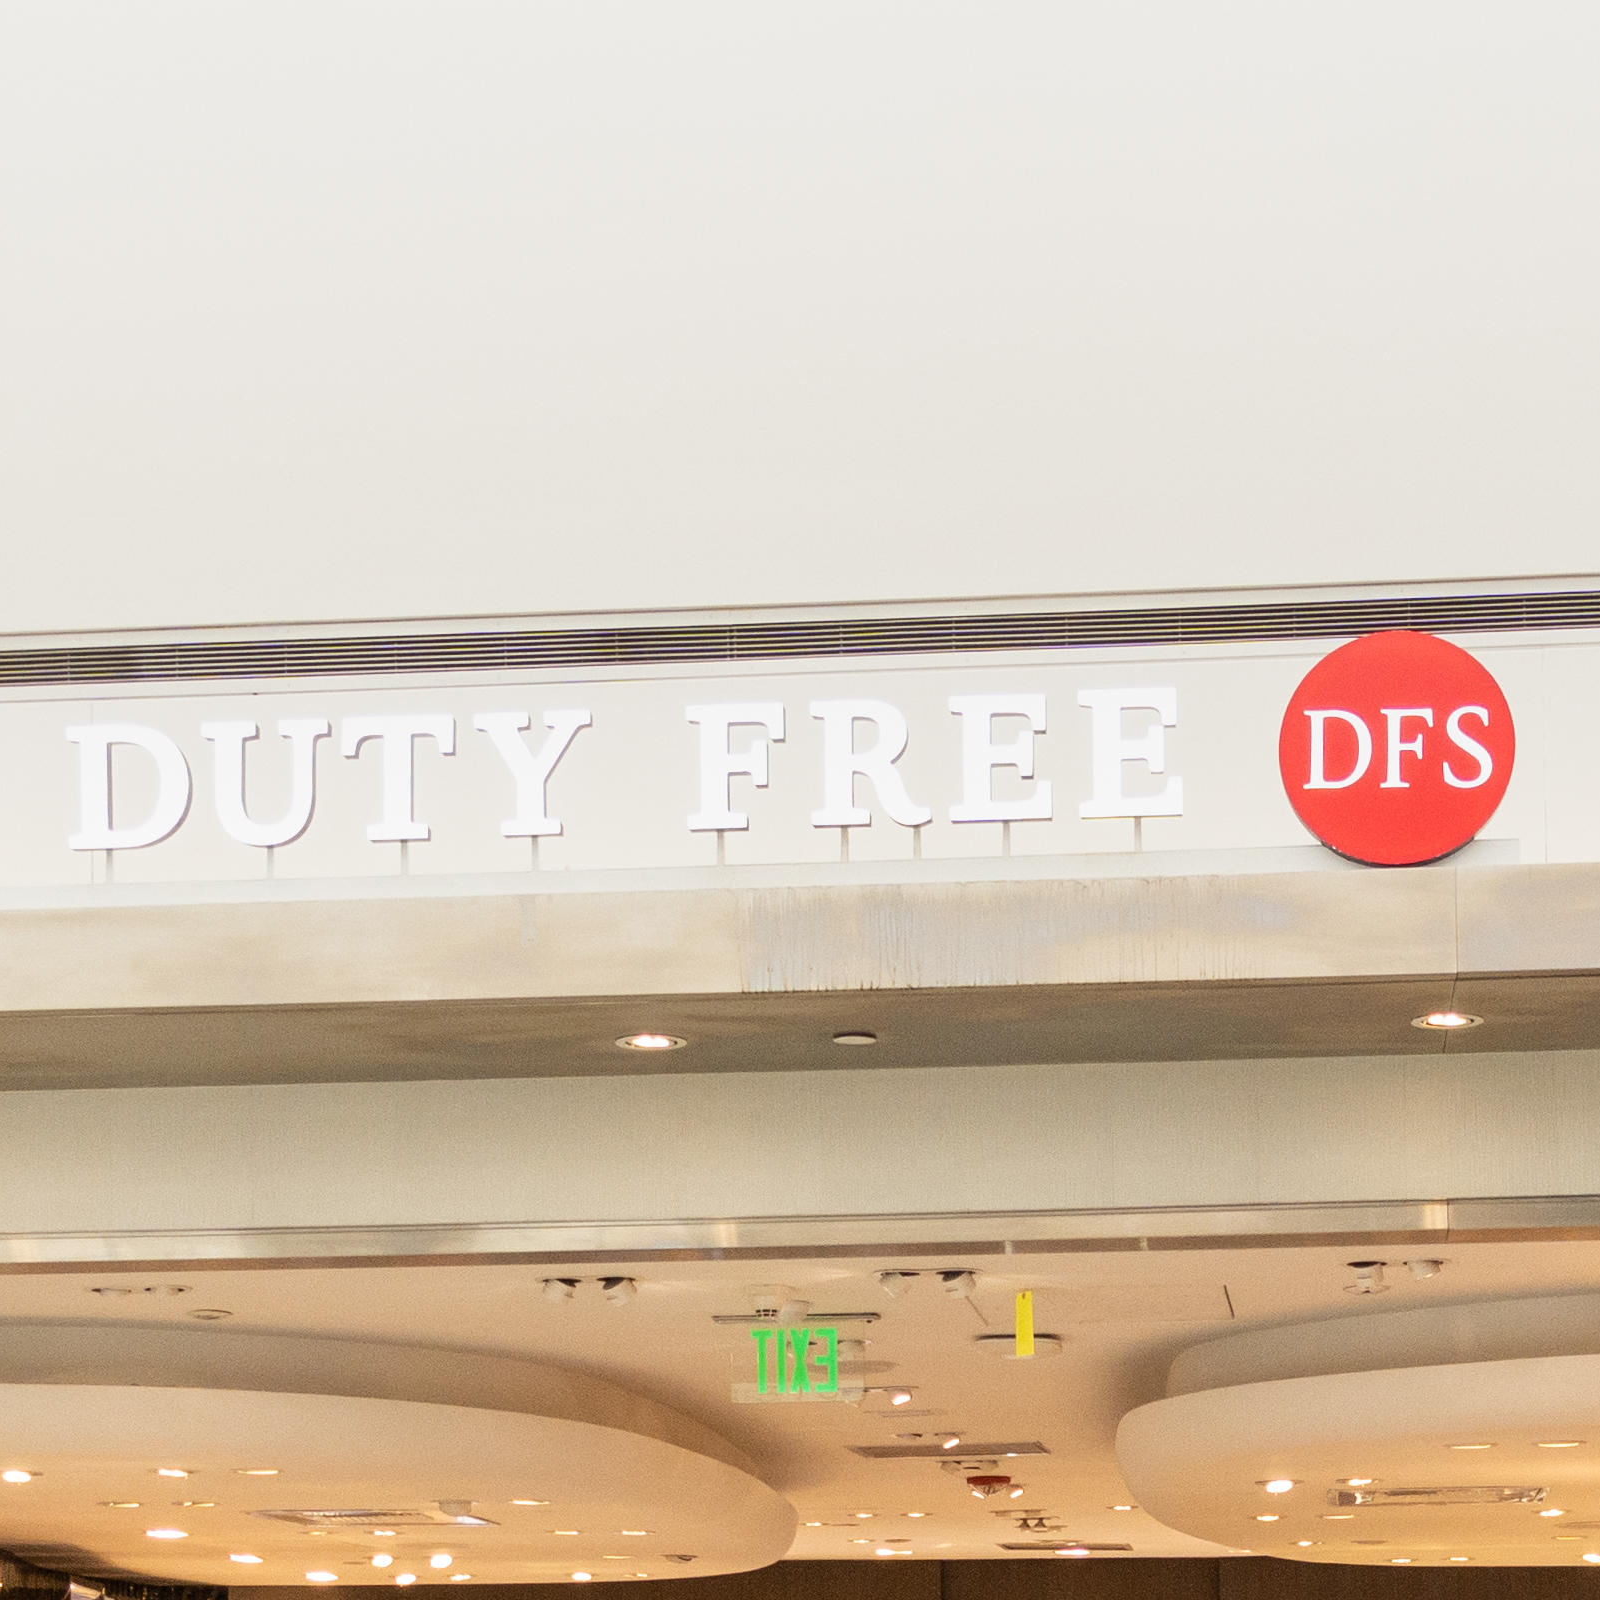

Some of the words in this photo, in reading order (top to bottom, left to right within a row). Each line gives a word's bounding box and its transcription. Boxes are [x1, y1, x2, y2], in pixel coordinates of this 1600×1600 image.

[66, 710, 593, 852] DUTY
[686, 686, 1185, 833] FREE
[1303, 704, 1495, 791] DFS
